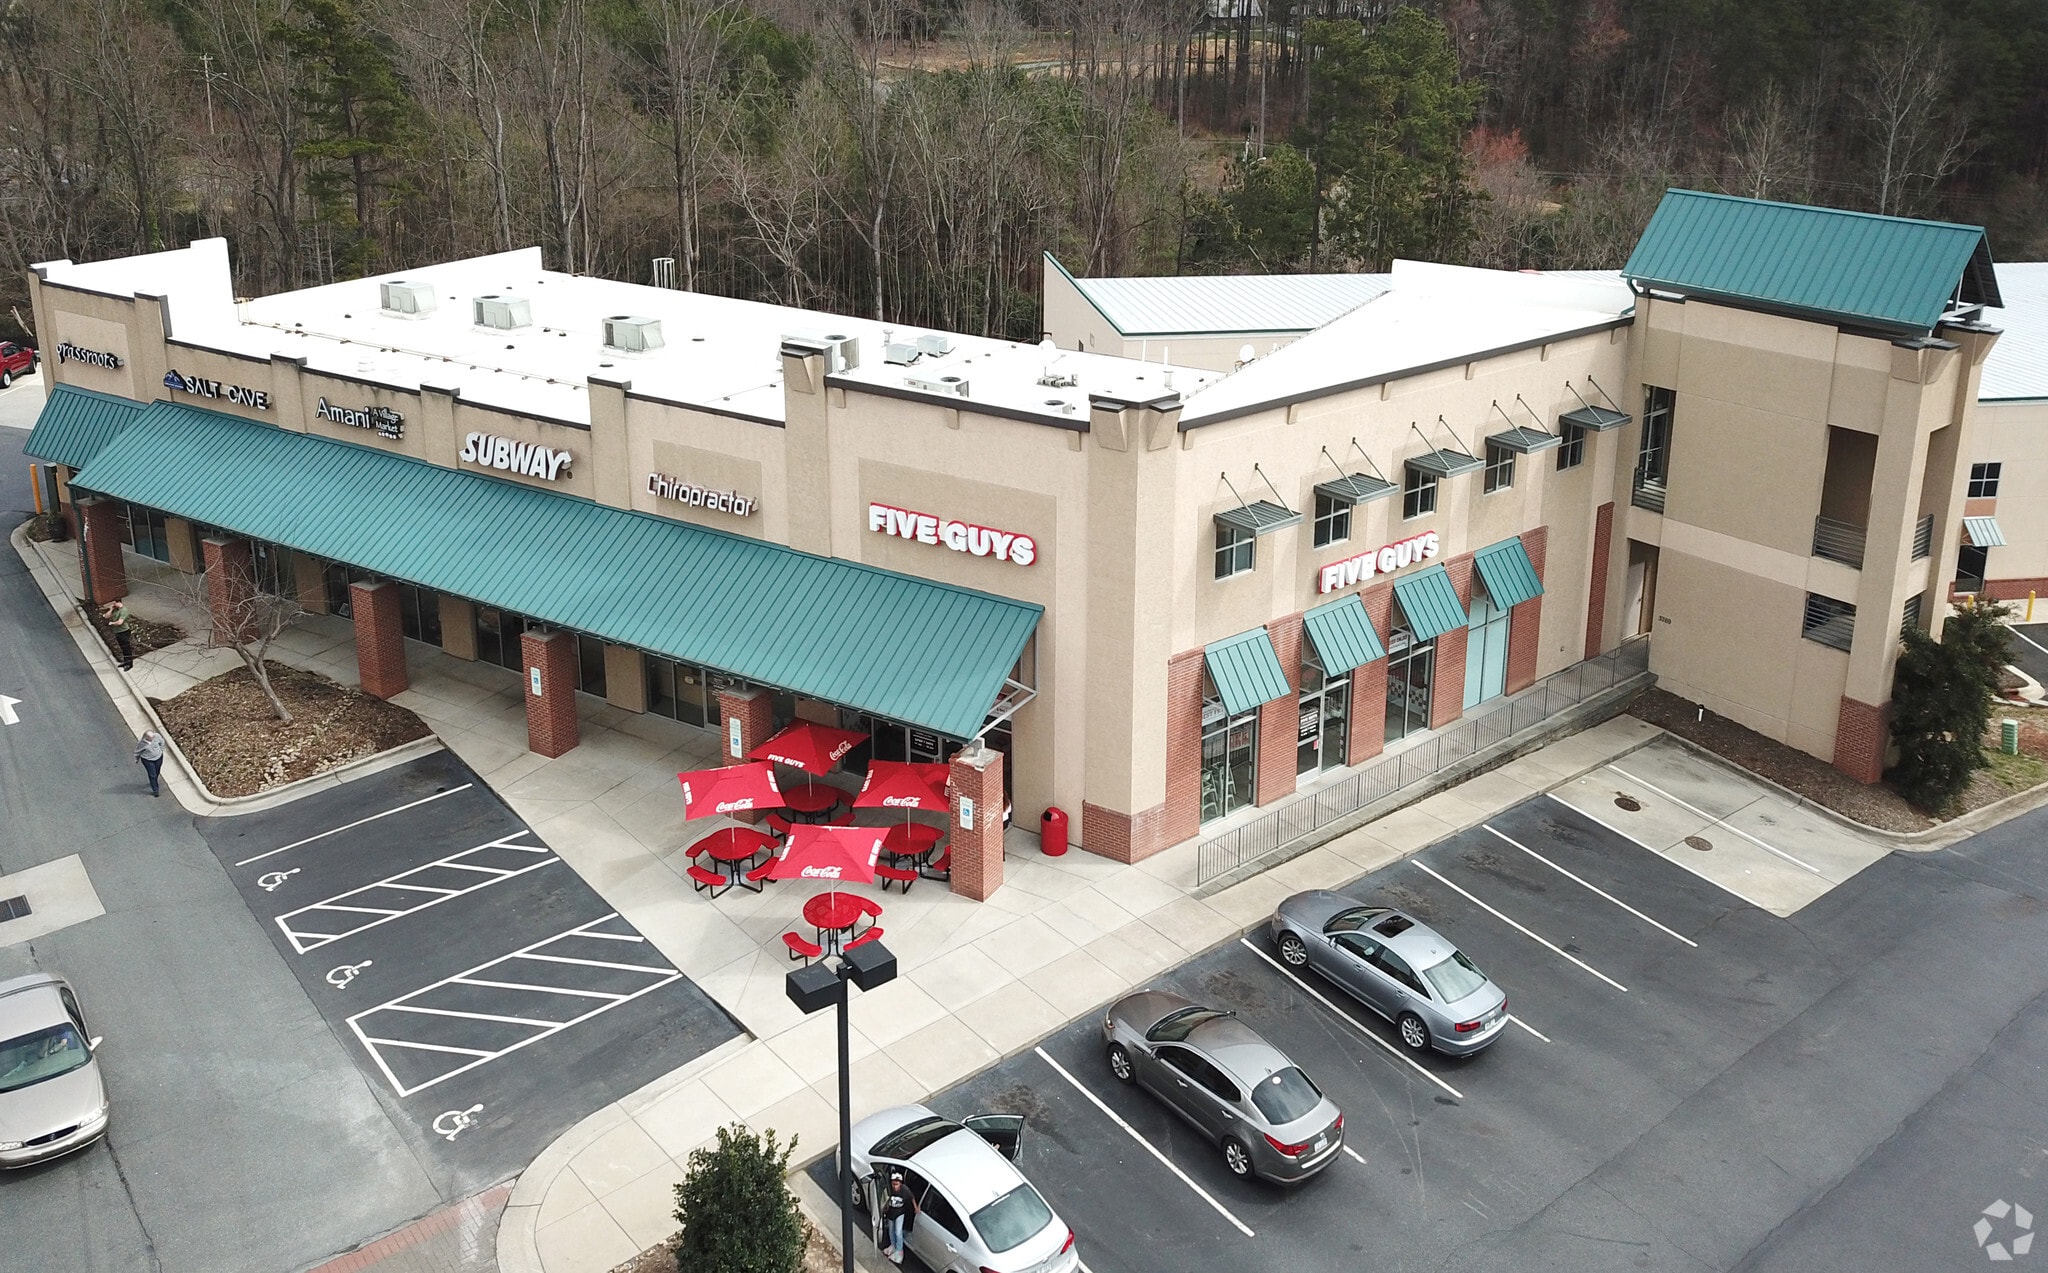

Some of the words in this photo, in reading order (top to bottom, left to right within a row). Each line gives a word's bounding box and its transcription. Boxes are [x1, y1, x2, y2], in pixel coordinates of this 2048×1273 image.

[56, 342, 118, 370] grassroots
[186, 376, 219, 399] SALT
[227, 386, 268, 411] CAVE
[316, 397, 370, 429] Amani
[458, 431, 573, 481] SUBWAY
[646, 472, 753, 518] Chiropractor
[868, 502, 940, 546] FIVE
[944, 520, 1037, 567] GUYS
[1320, 551, 1377, 594] FIVE
[1377, 531, 1440, 573] GUYS
[767, 753, 784, 763] FIVE
[784, 757, 806, 768] GUYS
